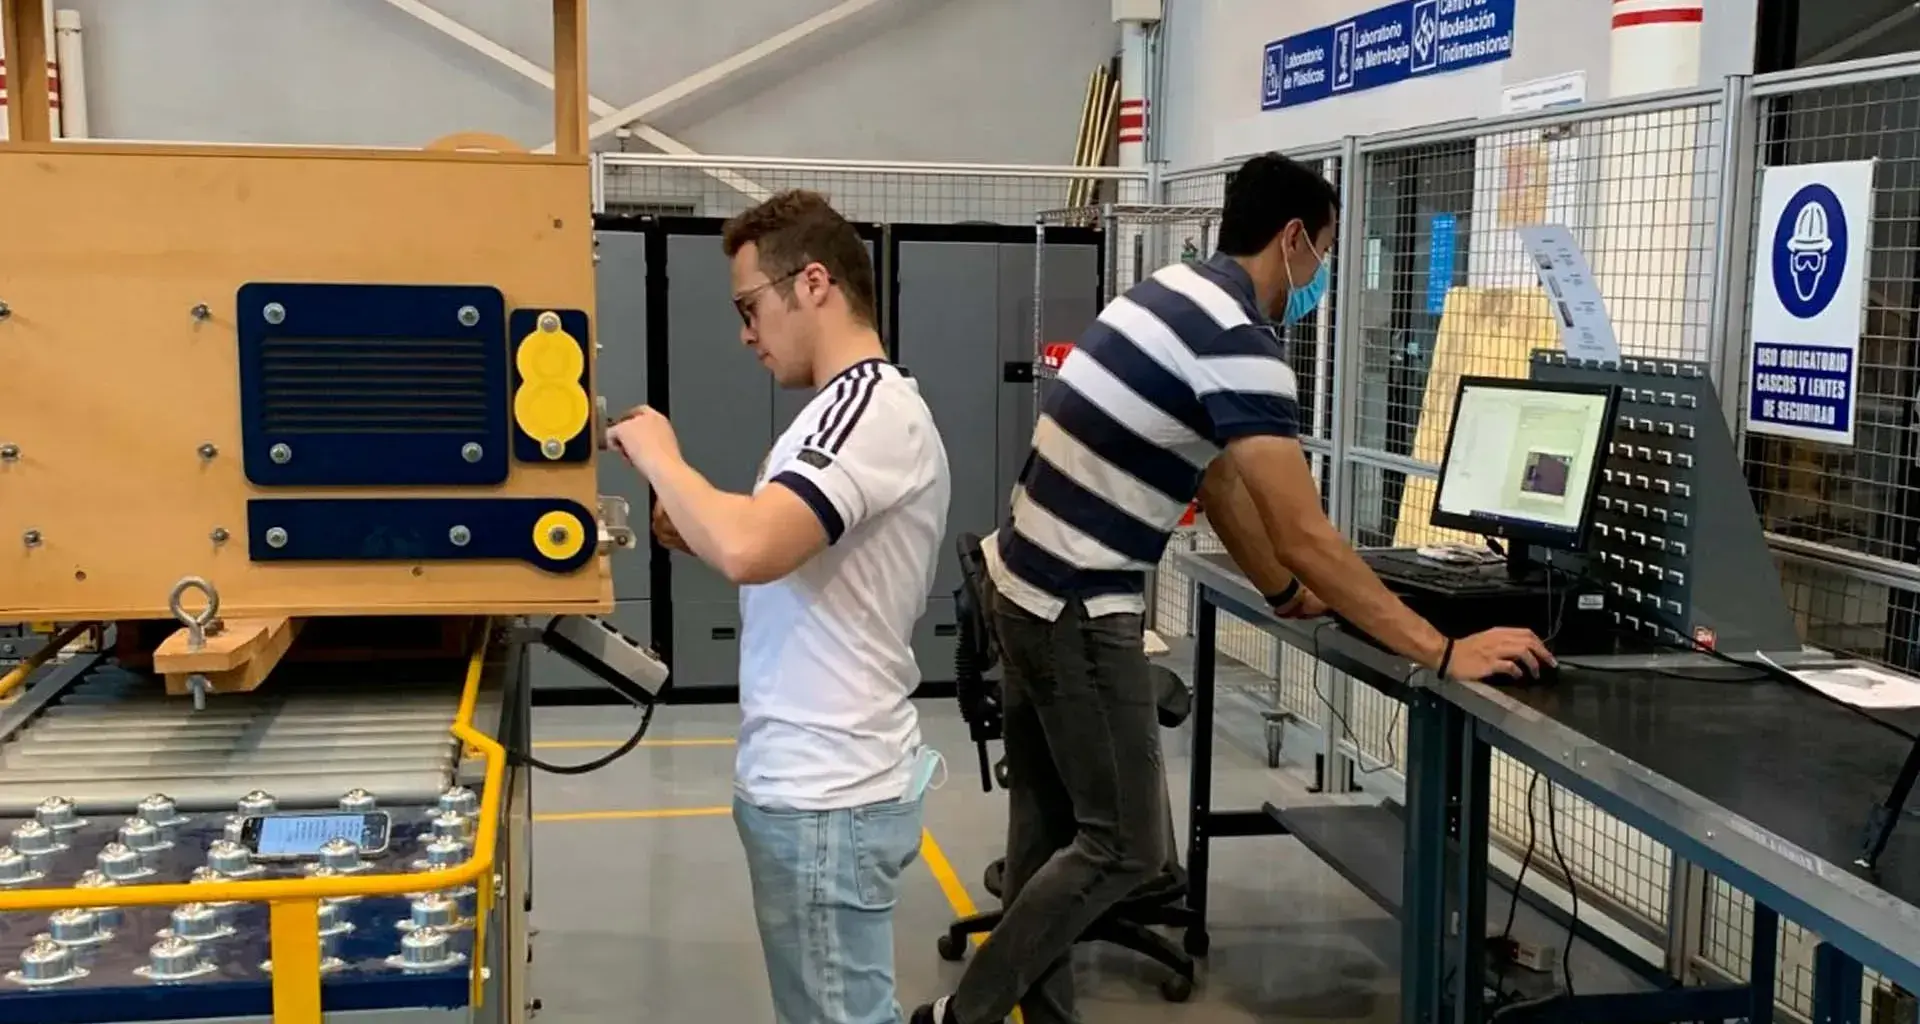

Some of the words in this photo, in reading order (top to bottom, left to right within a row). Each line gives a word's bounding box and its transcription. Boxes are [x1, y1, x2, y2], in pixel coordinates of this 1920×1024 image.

[1356, 20, 1402, 49] Laboratorio
[1439, 30, 1512, 64] Tridimensional
[1285, 46, 1325, 69] Laboratorio
[1355, 54, 1363, 71] de
[1757, 347, 1778, 367] USO
[1780, 349, 1848, 372] OBLIGATORIO
[1757, 372, 1796, 395] CASCOS
[1799, 376, 1807, 396] Y
[1808, 377, 1846, 400] LENTES
[1763, 399, 1776, 418] DE
[1777, 400, 1835, 425] SEGURIDAD
